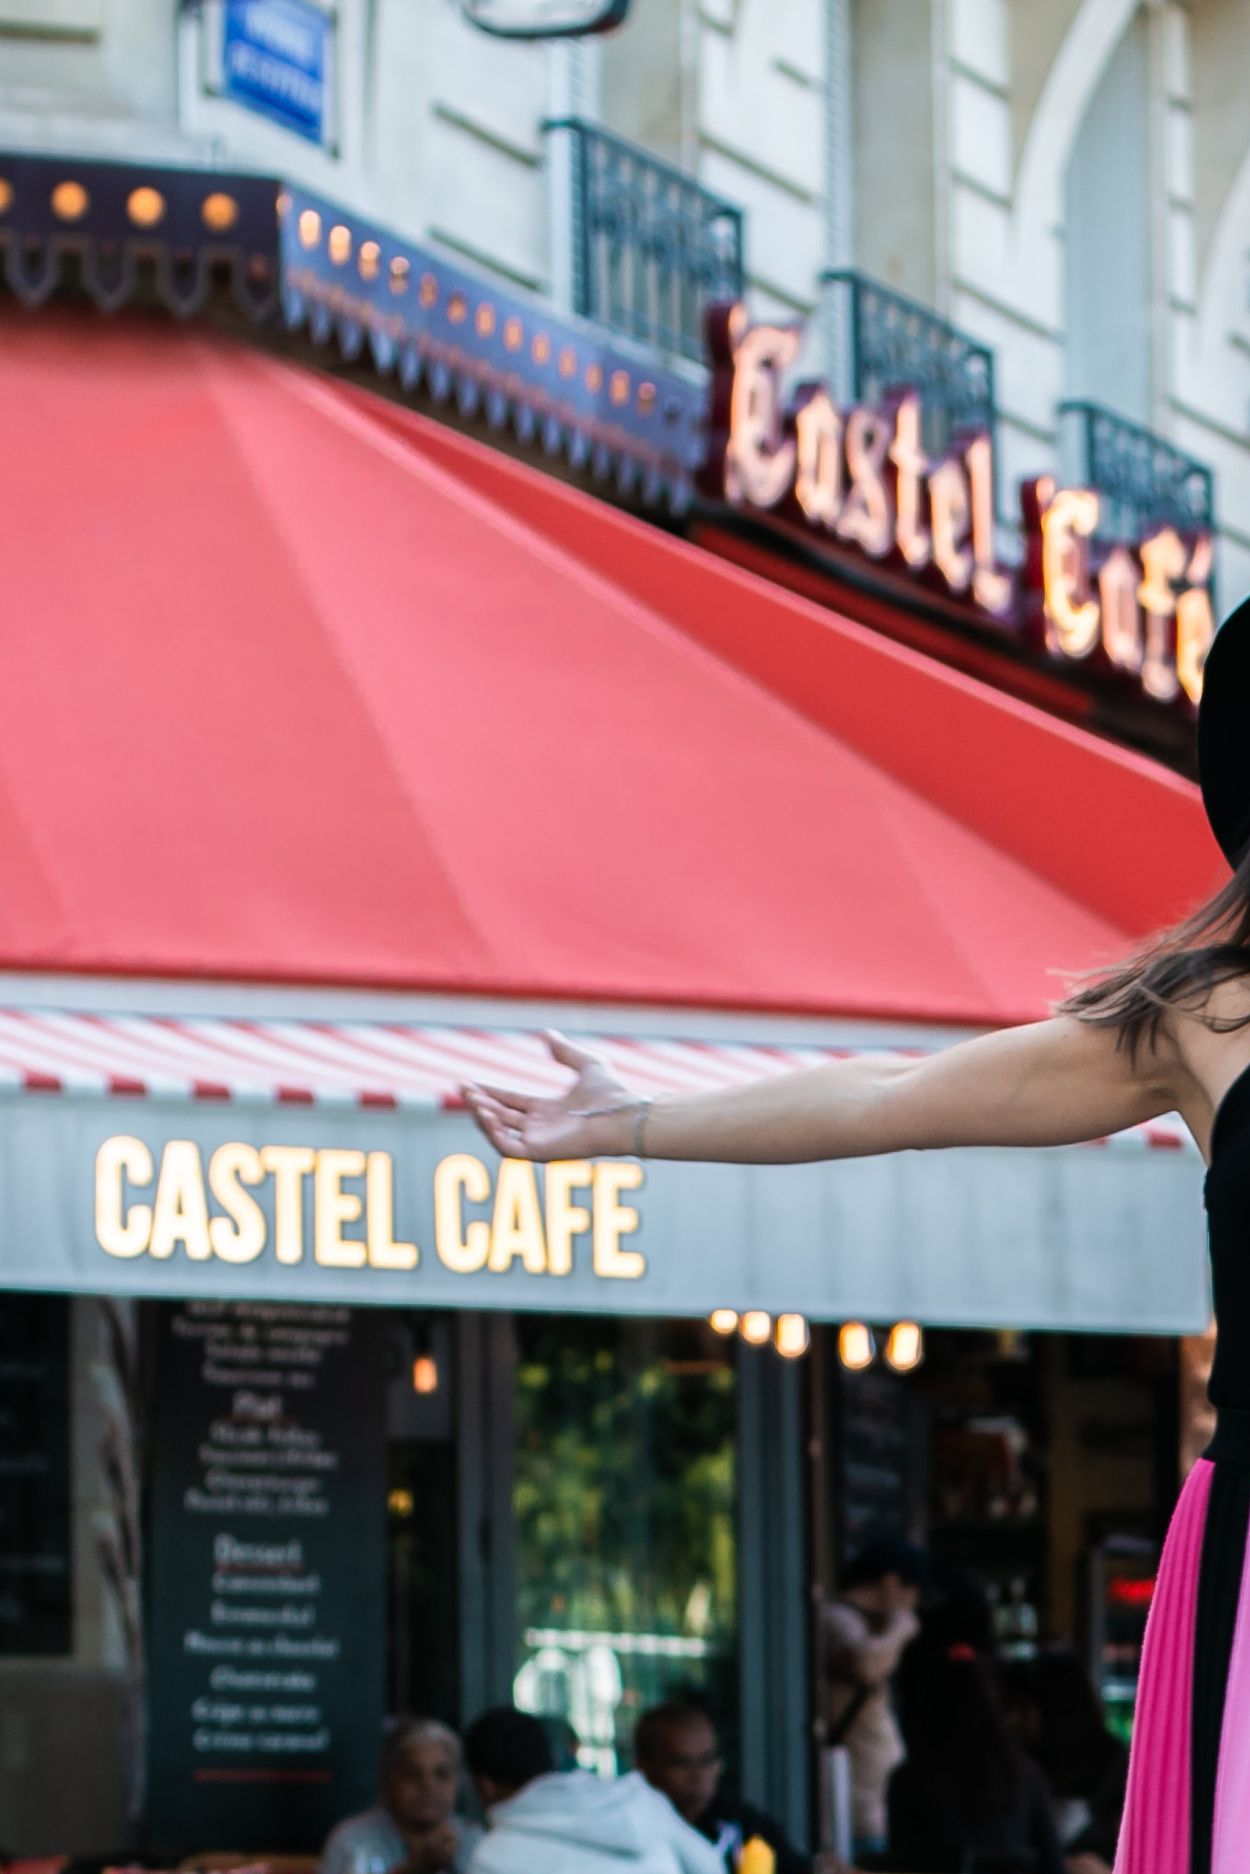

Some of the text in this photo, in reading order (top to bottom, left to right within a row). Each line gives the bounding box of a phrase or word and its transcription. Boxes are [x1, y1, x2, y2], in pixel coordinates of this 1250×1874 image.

[724, 302, 1010, 615] Castel
[97, 1134, 645, 1279] CASTEL CAFE
